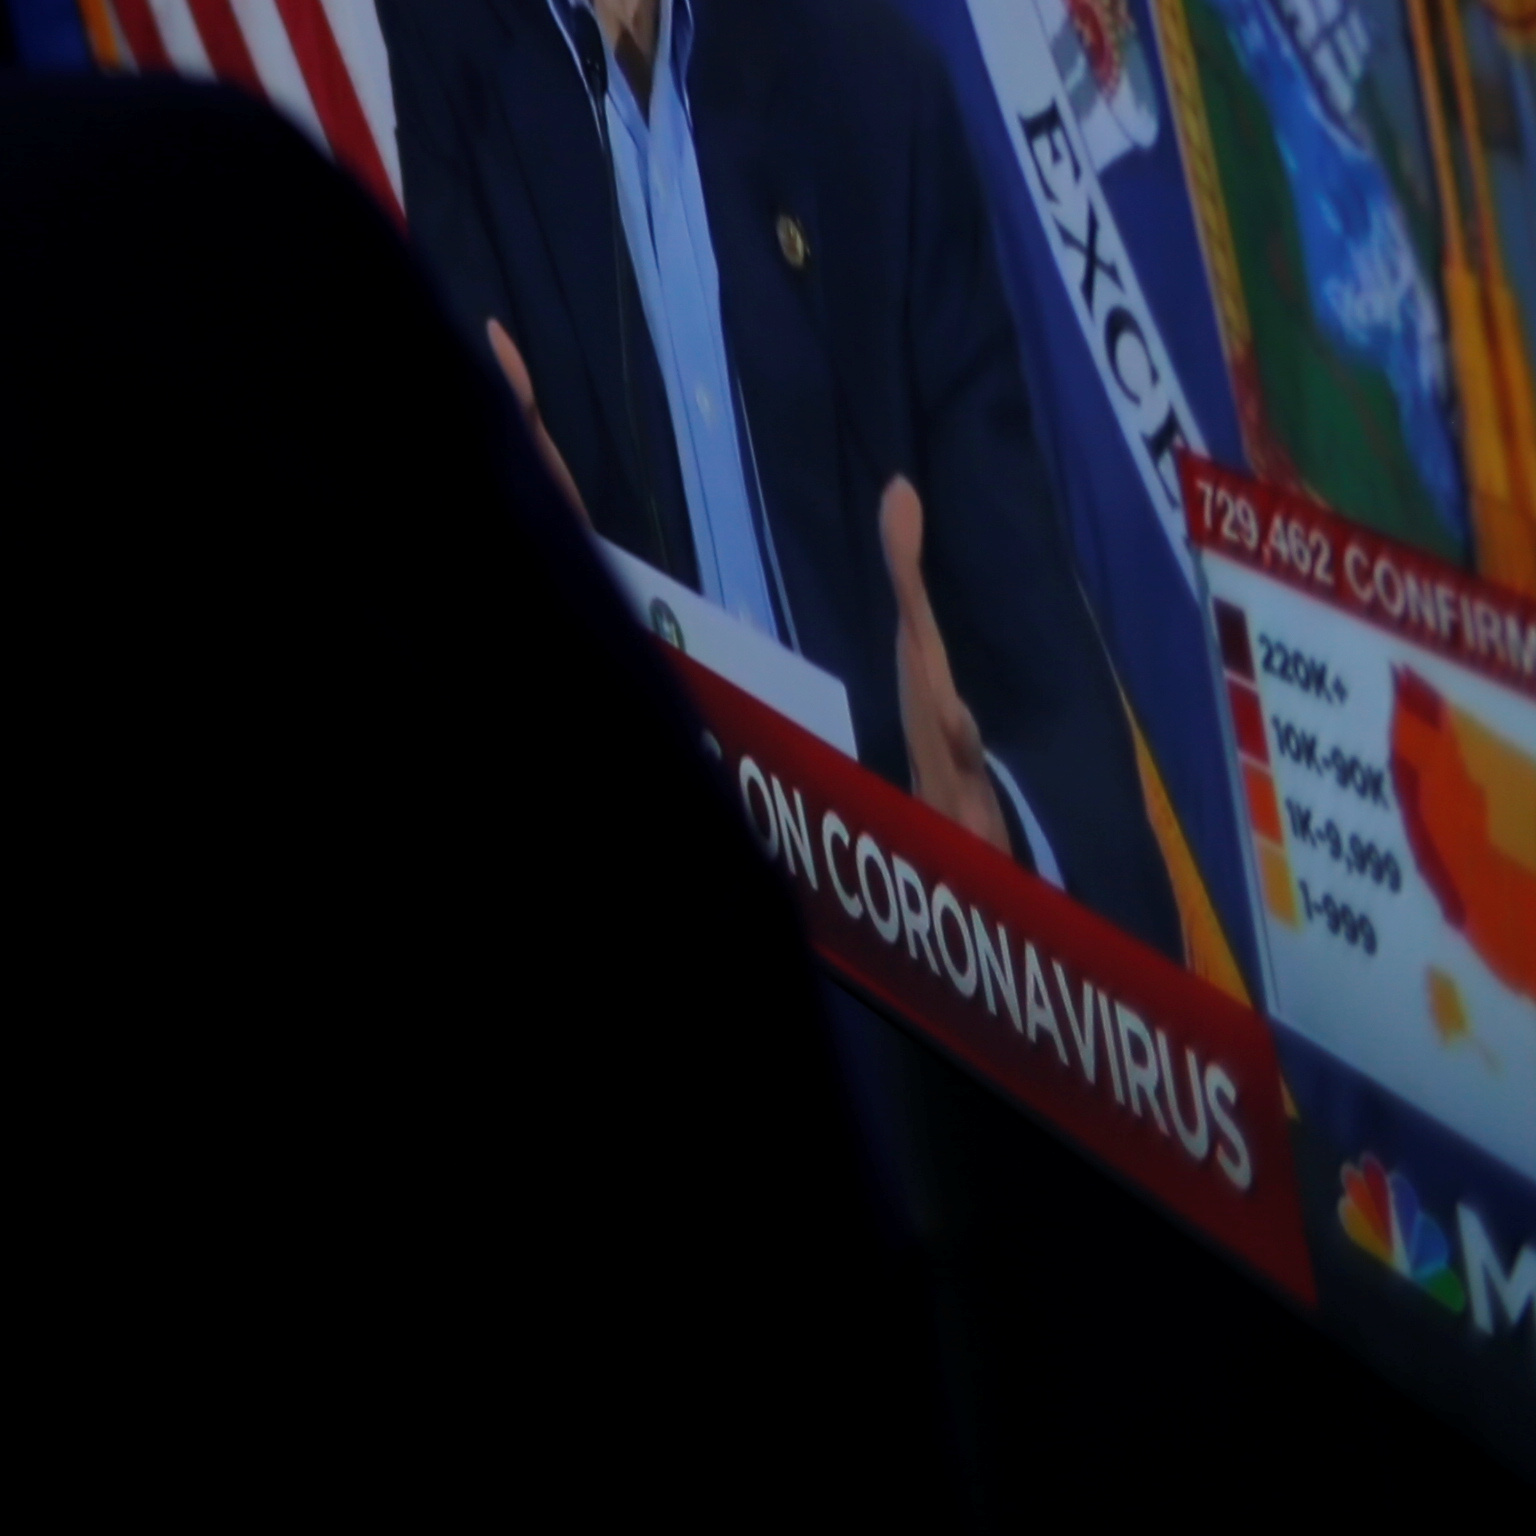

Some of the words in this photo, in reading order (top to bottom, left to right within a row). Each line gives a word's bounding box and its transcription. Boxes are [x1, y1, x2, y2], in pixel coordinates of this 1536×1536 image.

[1196, 478, 1336, 586] 729,462
[1299, 880, 1378, 957] 1-999
[738, 754, 820, 893] ON
[821, 809, 1254, 1194] CORONAVIRUS
